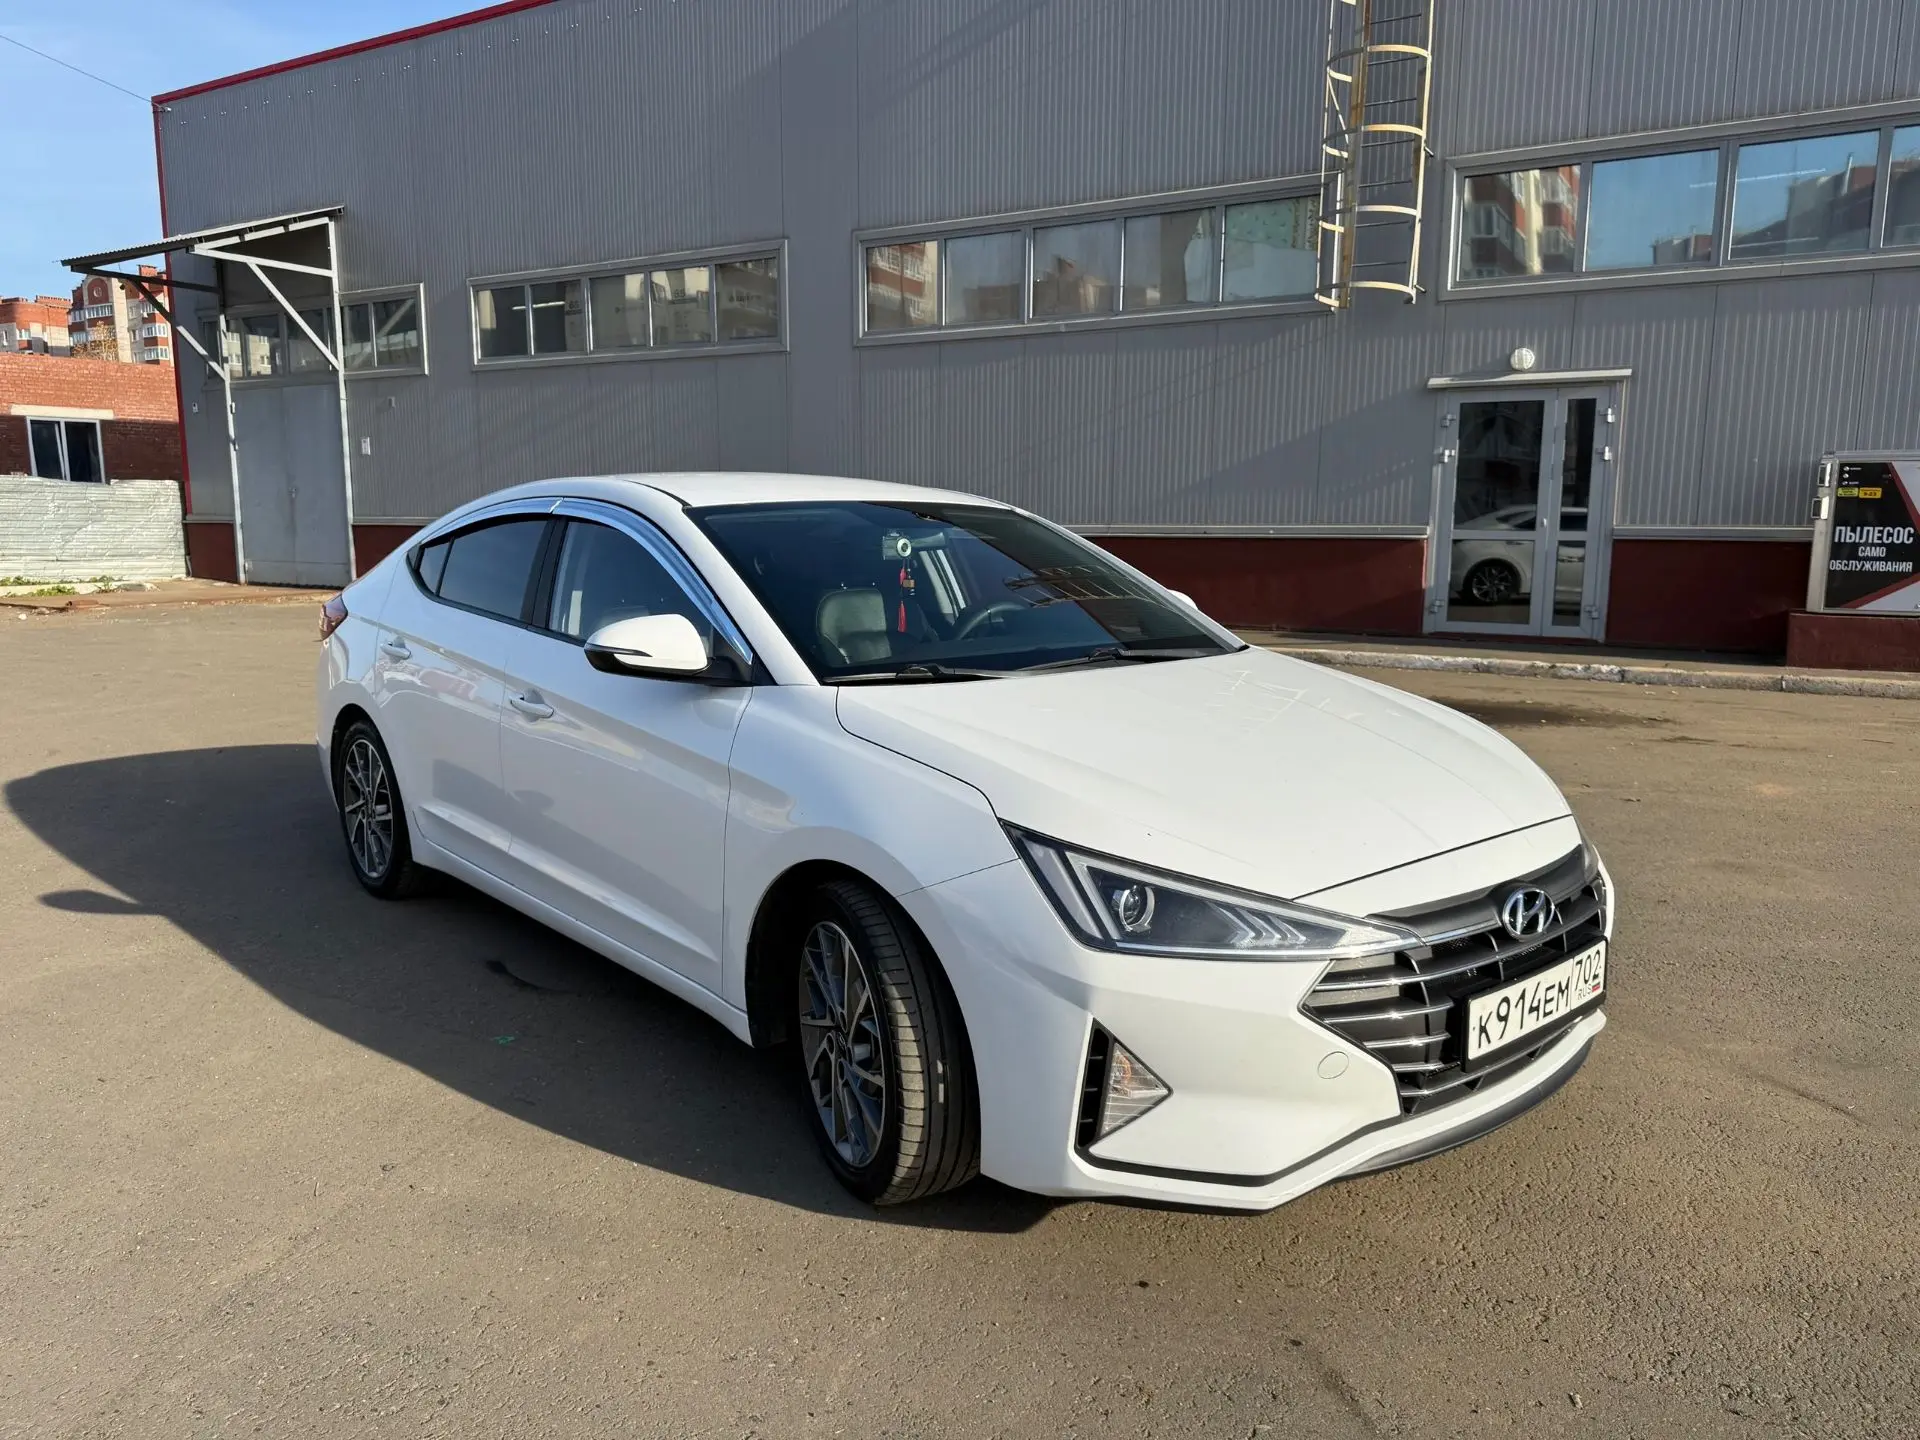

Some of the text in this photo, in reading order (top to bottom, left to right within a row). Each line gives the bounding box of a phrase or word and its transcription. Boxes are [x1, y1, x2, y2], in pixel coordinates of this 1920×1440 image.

[1834, 525, 1915, 544] ПЫЛЕСОС
[1858, 546, 1887, 557] САМО
[1829, 559, 1913, 572] ОБСЛУЖИВАНИЯ
[1478, 949, 1601, 1049] К914ЕМ 702
[1577, 983, 1592, 1000] RUS
